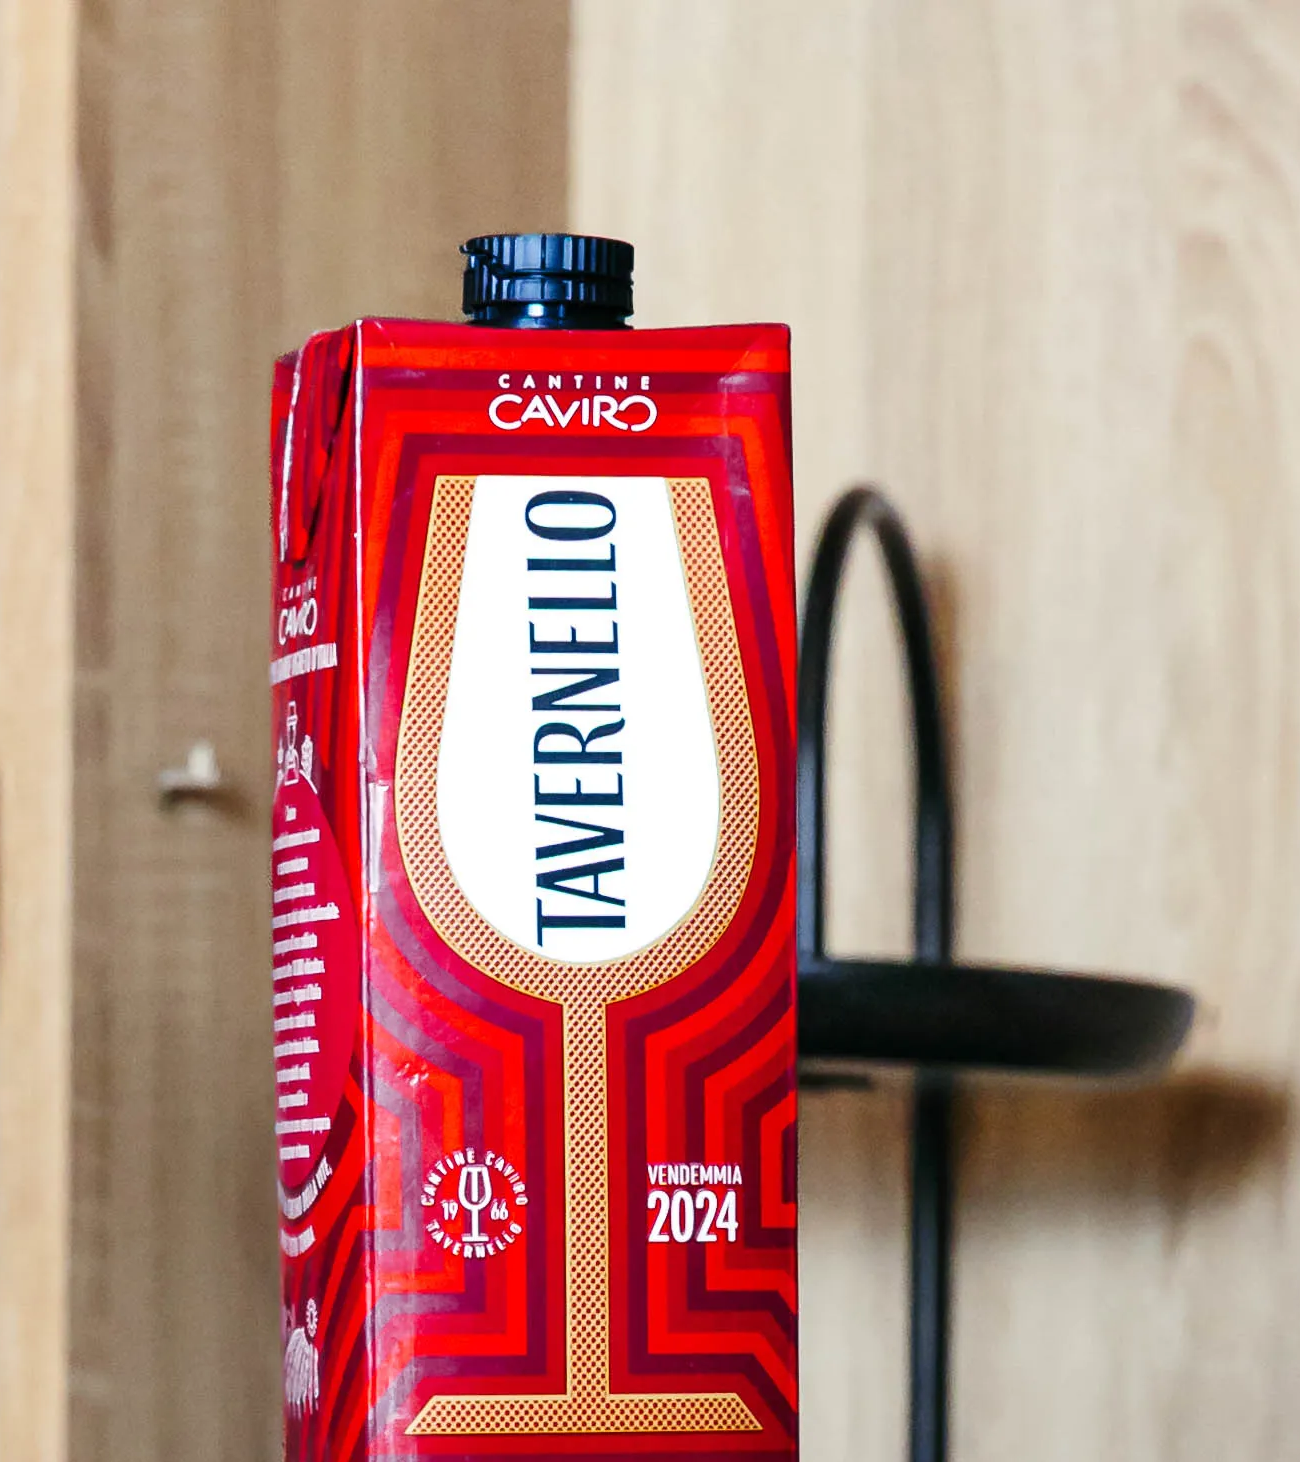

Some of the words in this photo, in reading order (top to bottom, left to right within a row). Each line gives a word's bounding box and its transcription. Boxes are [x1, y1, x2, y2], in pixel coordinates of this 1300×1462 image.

[498, 373, 651, 391] CANTINE
[488, 393, 658, 432] CAVIRO
[525, 490, 626, 947] TAVERNELLO
[421, 1147, 476, 1206] CANTINE
[485, 1150, 529, 1206] CAVIRO
[647, 1163, 743, 1187] VENDEMMIA
[441, 1199, 459, 1221] 19
[490, 1198, 509, 1221] 66
[647, 1189, 739, 1243] 2024
[426, 1219, 523, 1259] TAVERNELLO
